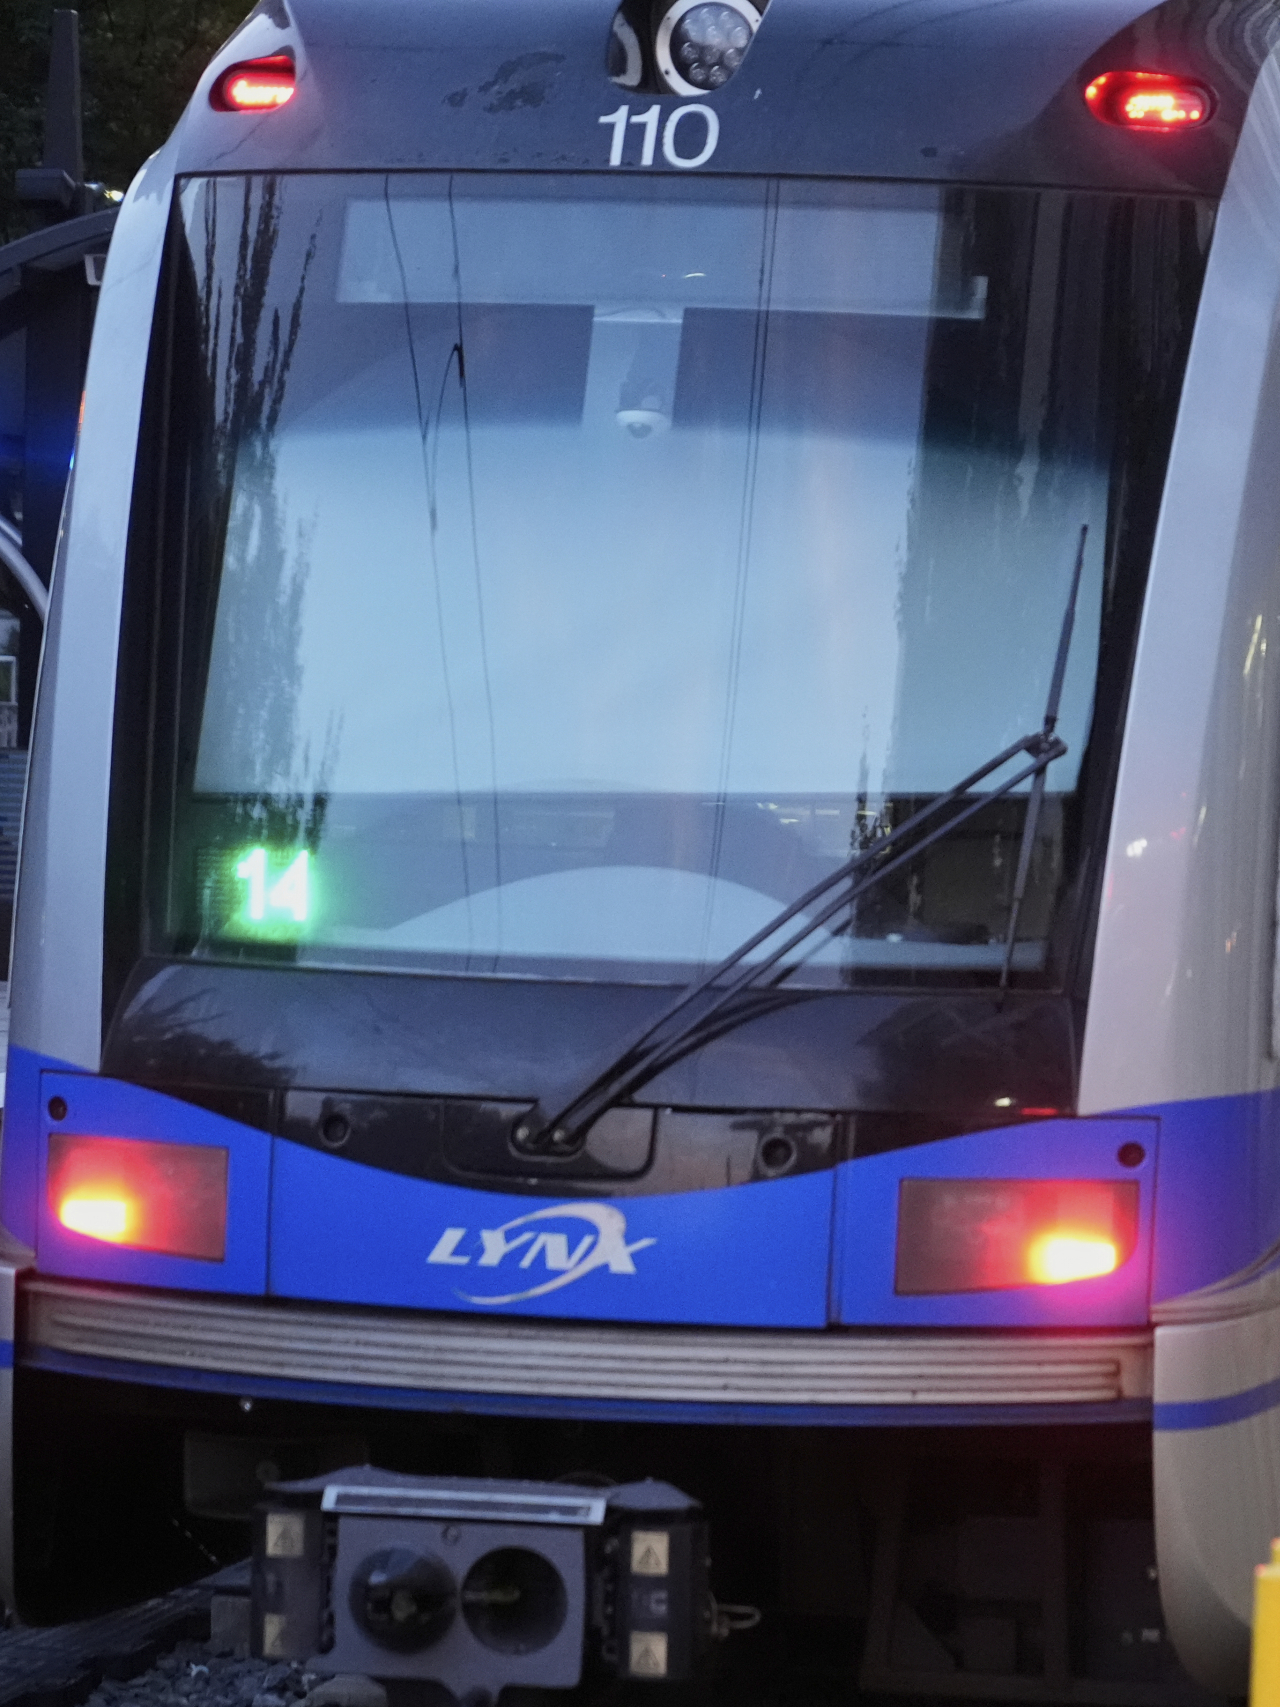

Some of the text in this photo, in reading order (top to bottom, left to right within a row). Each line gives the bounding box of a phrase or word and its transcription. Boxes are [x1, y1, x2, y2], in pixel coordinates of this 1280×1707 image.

[598, 103, 720, 168] 110
[236, 847, 309, 922] 14
[426, 1203, 657, 1275] LYNX
